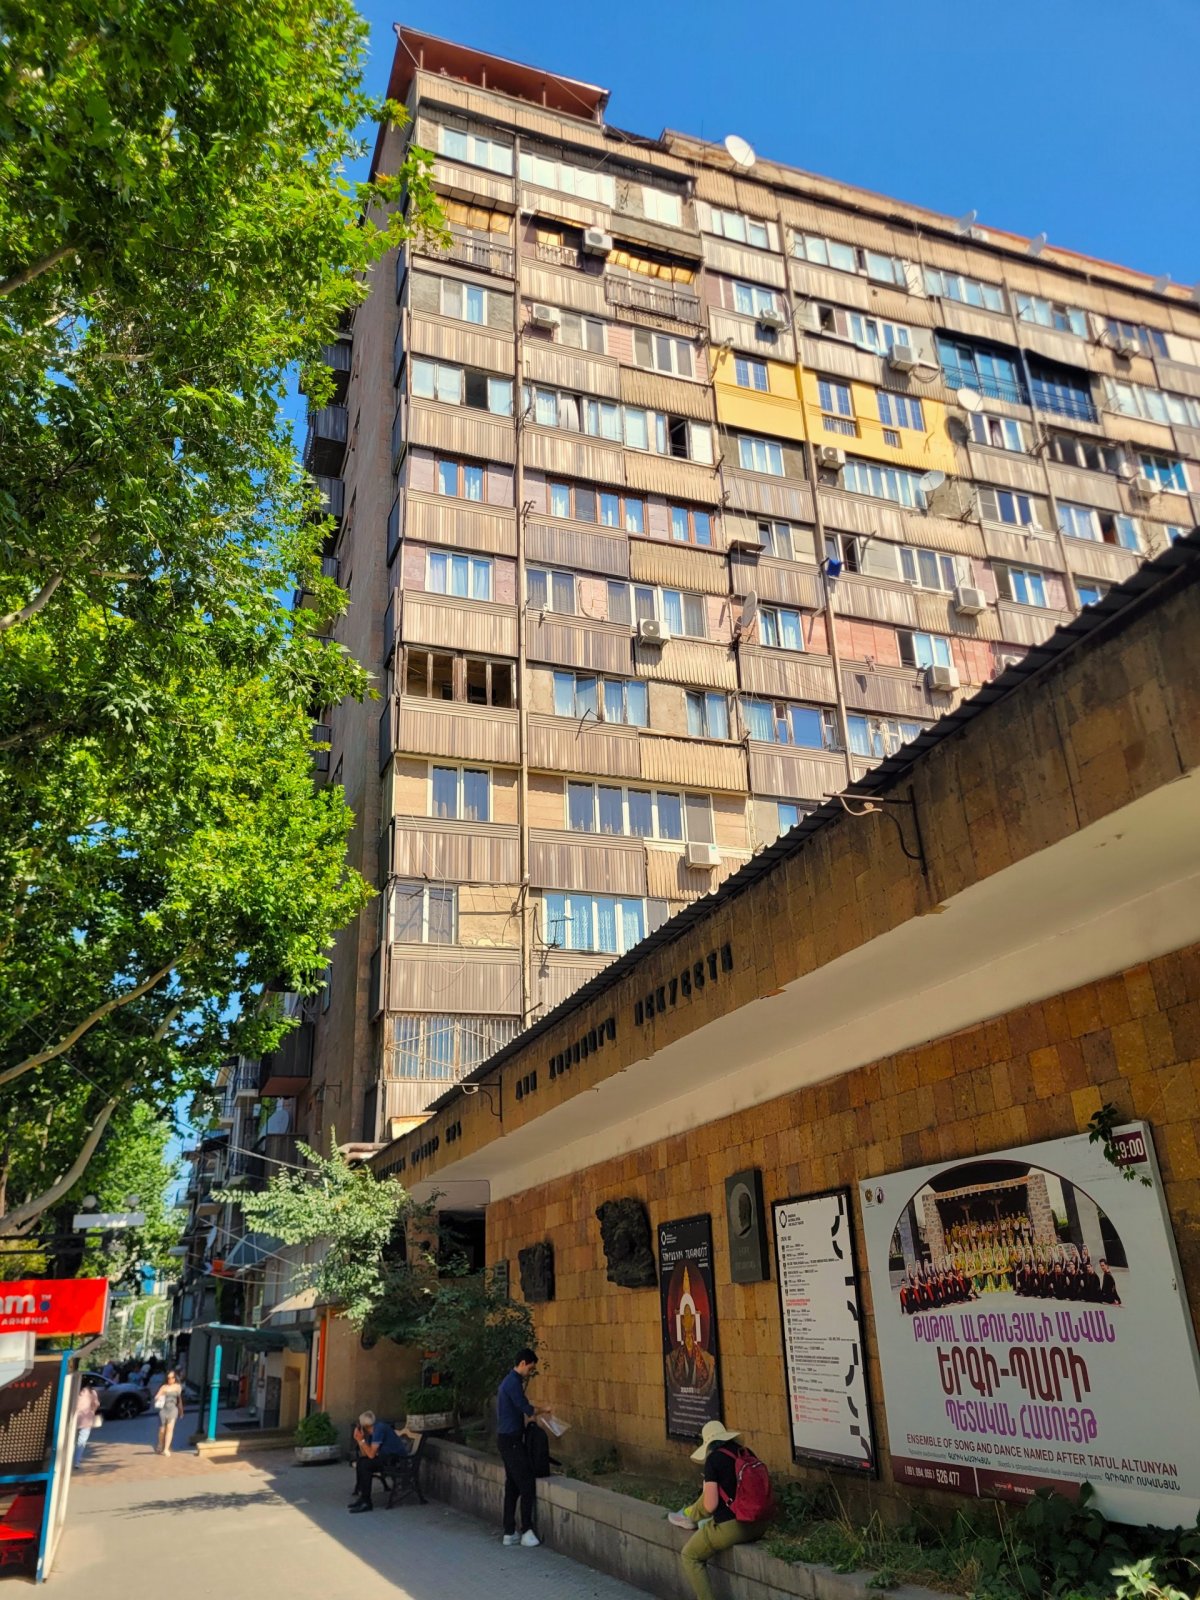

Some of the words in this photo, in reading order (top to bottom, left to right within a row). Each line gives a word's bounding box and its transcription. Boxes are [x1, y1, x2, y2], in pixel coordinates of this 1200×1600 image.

[1, 1317, 49, 1326] ARMENIA
[936, 1346, 1091, 1403] ԵՐԳԻ-ՊԱՐԻ
[945, 1399, 1017, 1437] ՊԵՏԱԿԱՆ
[906, 1433, 942, 1448] ENSEMBLE
[943, 1439, 953, 1449] OF
[954, 1440, 976, 1452] SONG
[976, 1442, 993, 1454] AND
[994, 1444, 1022, 1458] DANCE
[1023, 1447, 1054, 1462] NAMED
[1056, 1451, 1087, 1466] AFTER
[1088, 1455, 1120, 1470] TATUL
[1121, 1458, 1178, 1477] ALTUNYAN
[936, 1469, 949, 1484] 526
[949, 1471, 961, 1486] 477
